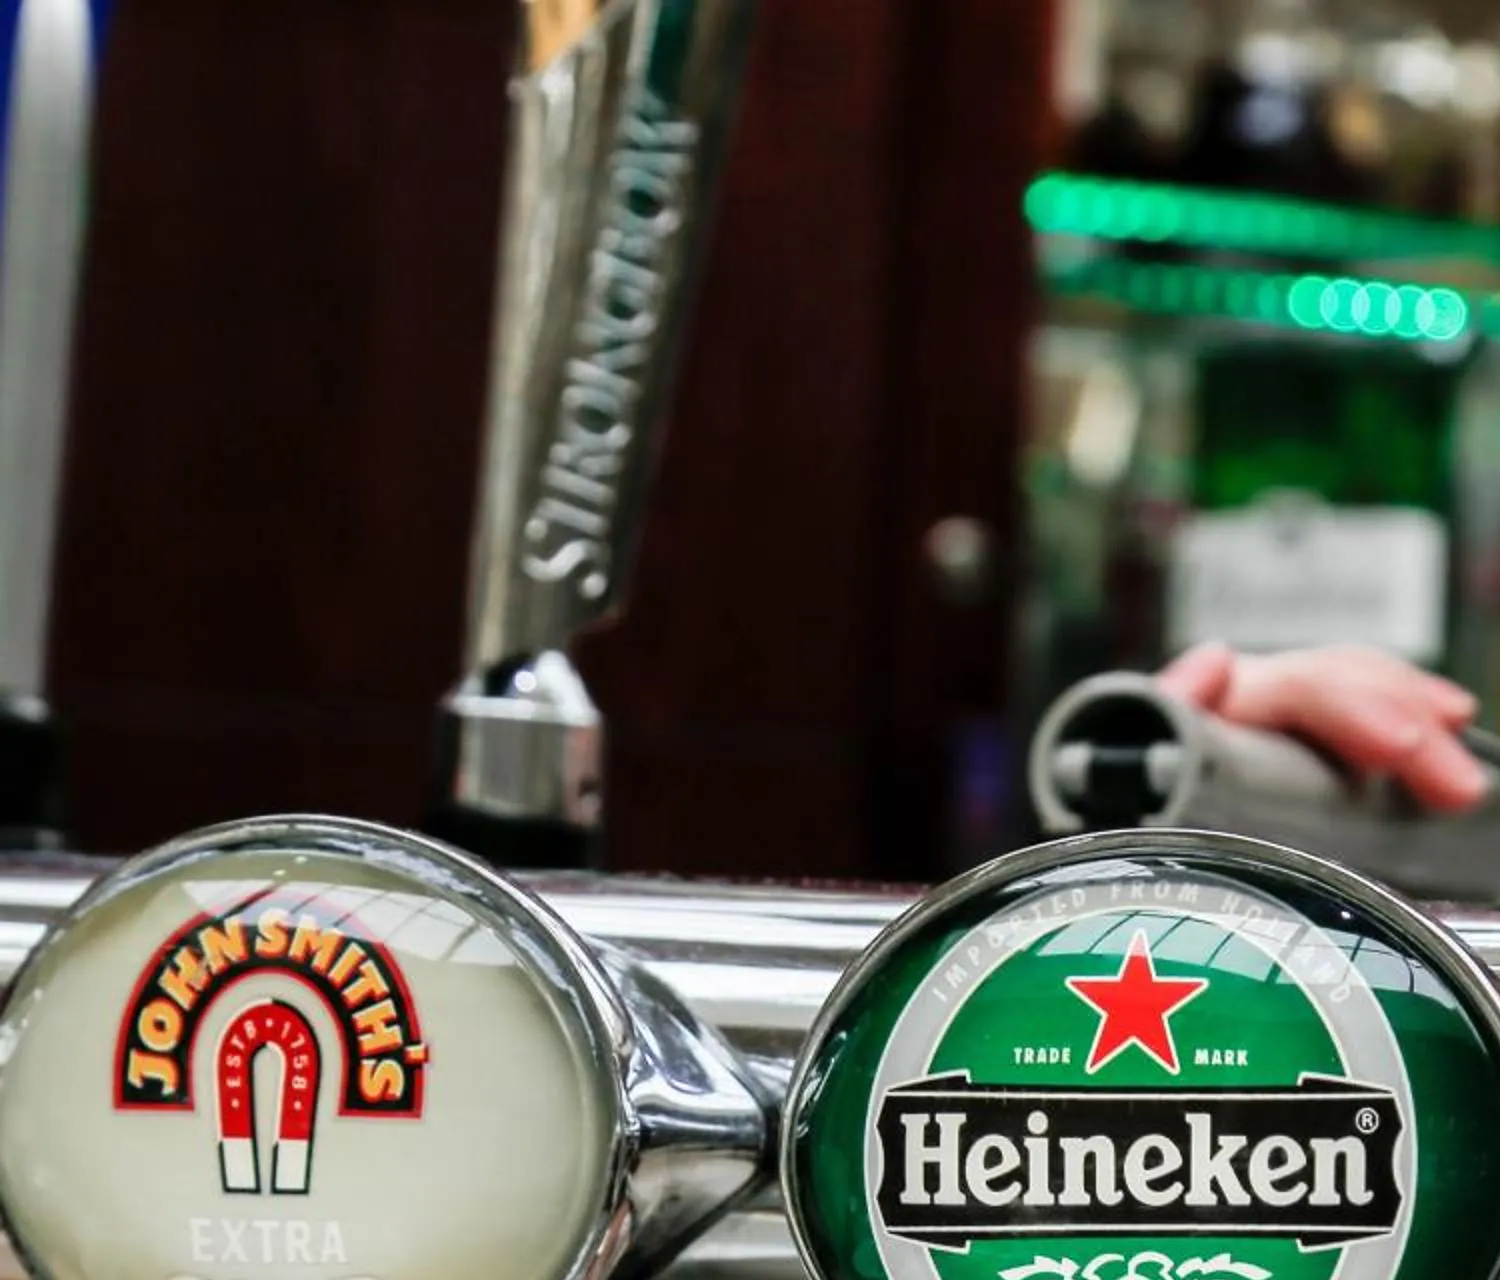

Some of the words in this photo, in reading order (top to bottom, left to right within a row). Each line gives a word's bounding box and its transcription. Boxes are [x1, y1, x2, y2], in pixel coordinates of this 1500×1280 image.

[520, 88, 698, 600] STRONGBOW
[931, 887, 1087, 1004] IMPORTED
[1110, 880, 1199, 904] FROM
[127, 915, 248, 1096] JOHN
[254, 908, 428, 1103] SMITH'S
[225, 1019, 257, 1089] ESTB
[281, 1021, 308, 1090] 1758
[1013, 1047, 1071, 1065] TRADE
[1193, 1049, 1249, 1066] MARK
[189, 1217, 348, 1264] EXTRA
